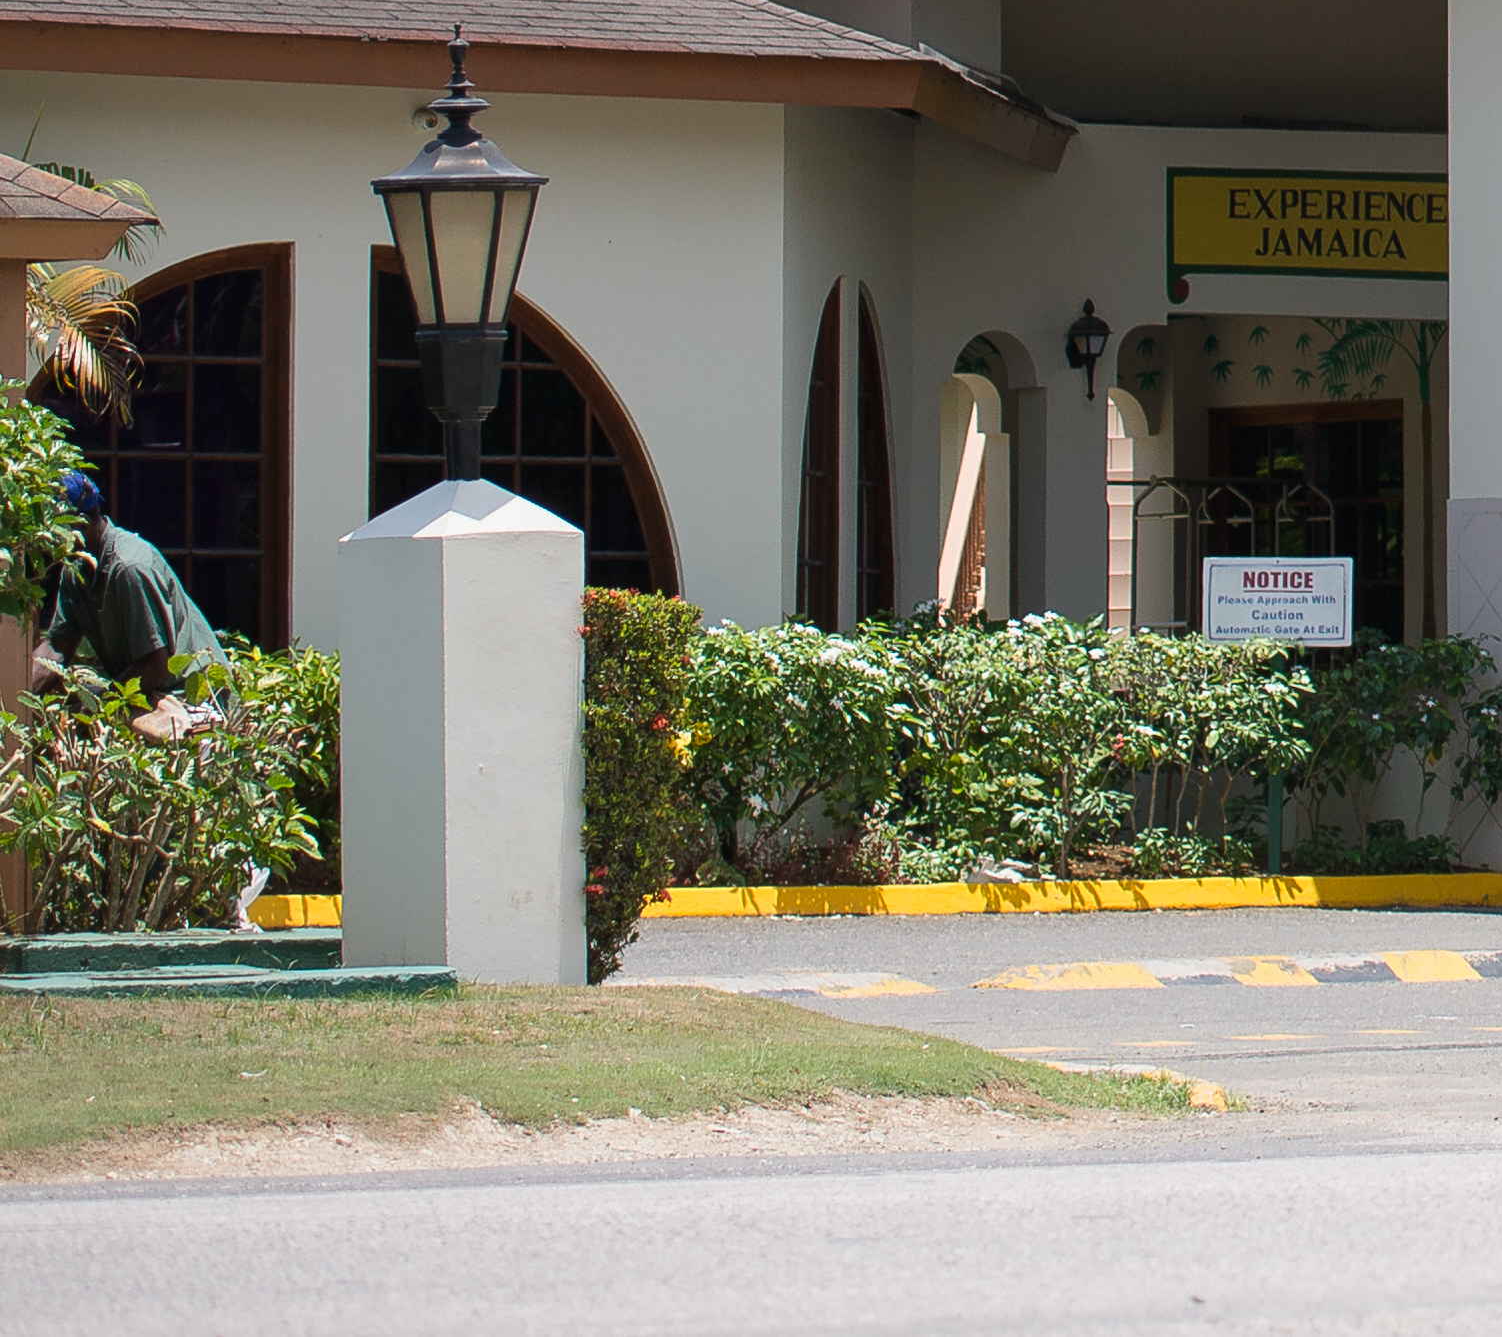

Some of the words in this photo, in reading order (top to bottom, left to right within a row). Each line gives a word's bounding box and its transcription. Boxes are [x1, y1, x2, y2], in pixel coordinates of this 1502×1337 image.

[1227, 188, 1447, 224] EXPERIENCE
[1254, 227, 1407, 260] JAMAICA
[1243, 571, 1314, 589] NOTICE
[1217, 595, 1253, 605] Please
[1257, 595, 1308, 606] Approach
[1311, 594, 1336, 604] With
[1251, 609, 1304, 620] Caution
[1215, 625, 1271, 635] Automatic
[1274, 625, 1299, 634] Gate
[1303, 625, 1315, 634] At
[1318, 625, 1339, 634] Exit
